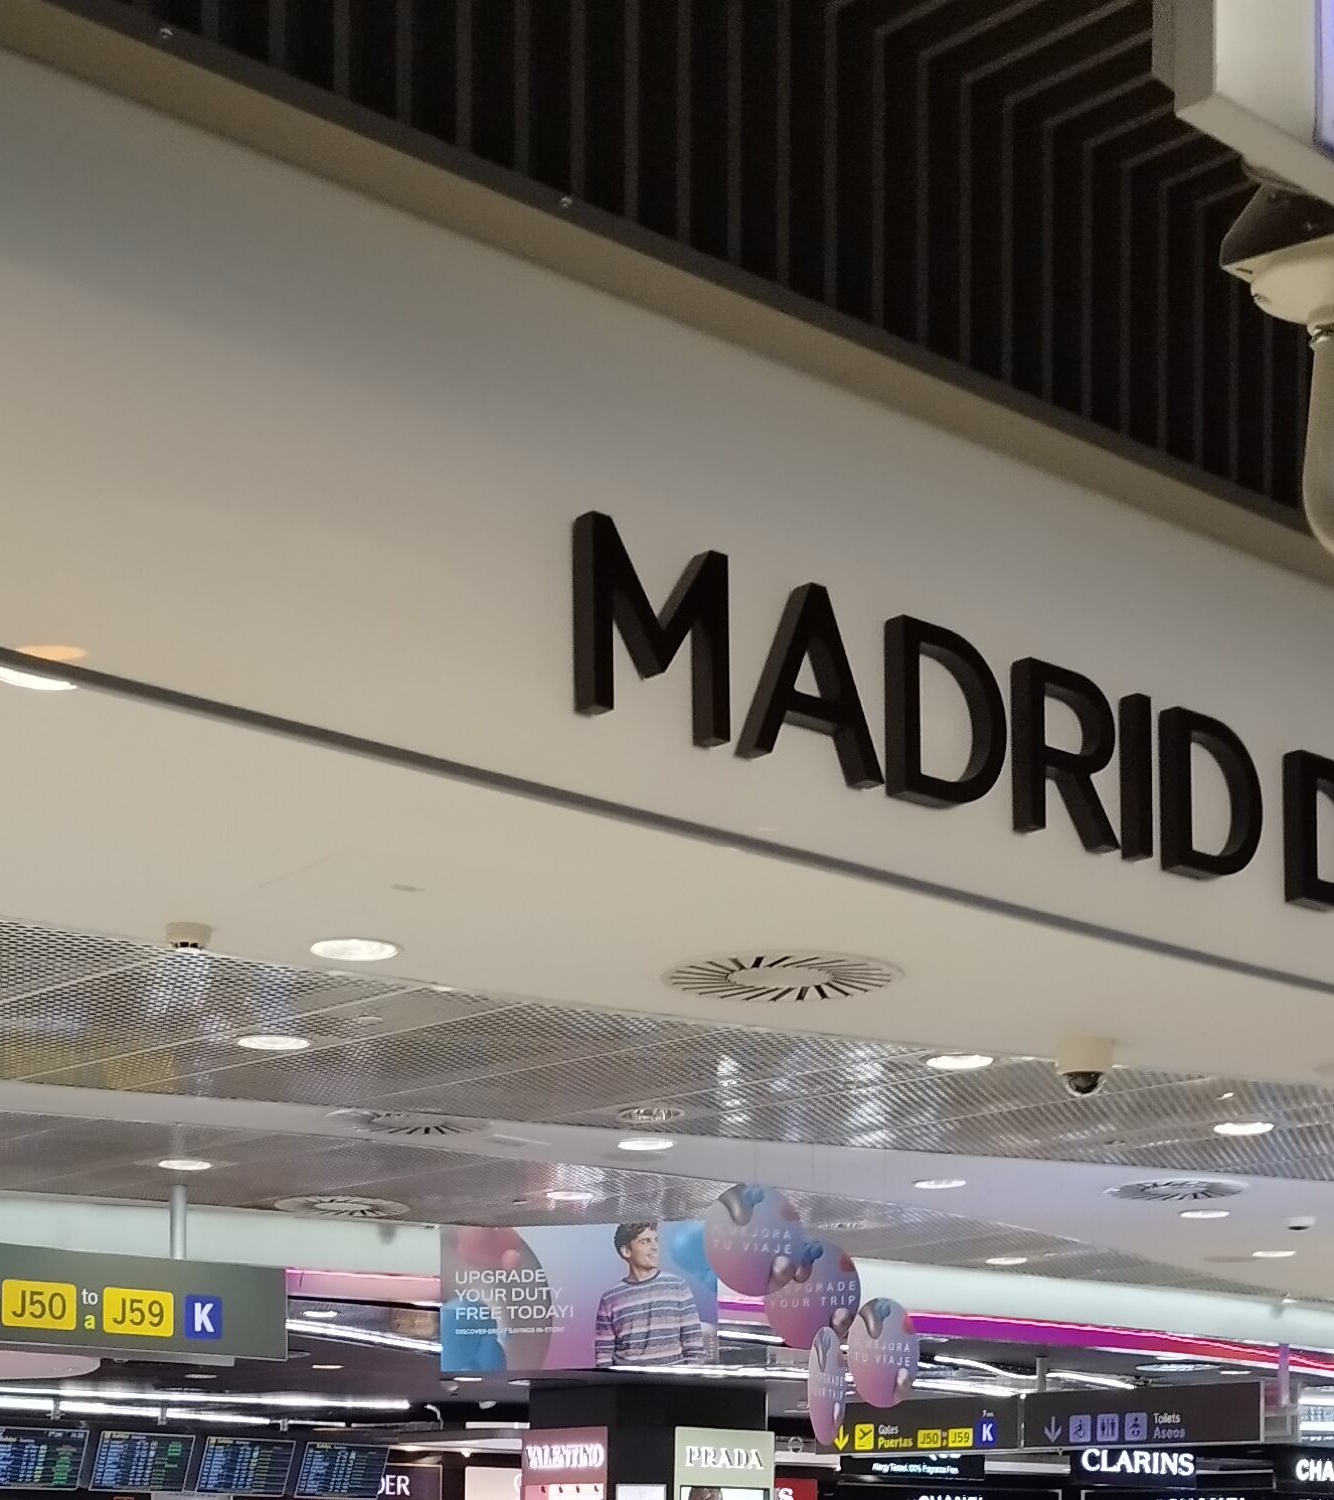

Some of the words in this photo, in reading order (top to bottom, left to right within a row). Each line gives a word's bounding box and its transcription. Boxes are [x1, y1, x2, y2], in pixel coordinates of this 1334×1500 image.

[573, 510, 1262, 880] MADRID
[743, 1242, 792, 1254] VIAJE
[455, 1268, 547, 1285] UPGRADE
[455, 1288, 507, 1302] YOUR
[511, 1287, 563, 1301] DUTY
[819, 1295, 856, 1306] TRIP
[11, 1290, 66, 1322] J50
[82, 1288, 99, 1306] to
[112, 1297, 165, 1328] J59
[192, 1303, 215, 1334] K
[455, 1305, 503, 1320] FREE
[506, 1305, 574, 1320] TODAY!
[83, 1313, 96, 1330] a
[874, 1353, 911, 1367] VIAJE
[1153, 1412, 1181, 1425] Toilets
[878, 1424, 900, 1436] Gates
[878, 1436, 914, 1449] Puertas
[920, 1432, 939, 1445] J50
[951, 1431, 970, 1443] J59
[982, 1423, 994, 1442] K
[1153, 1426, 1185, 1440] Aseos
[526, 1442, 605, 1470] VALENTINO
[685, 1445, 765, 1471] PRADA
[1081, 1448, 1195, 1477] CLARINS
